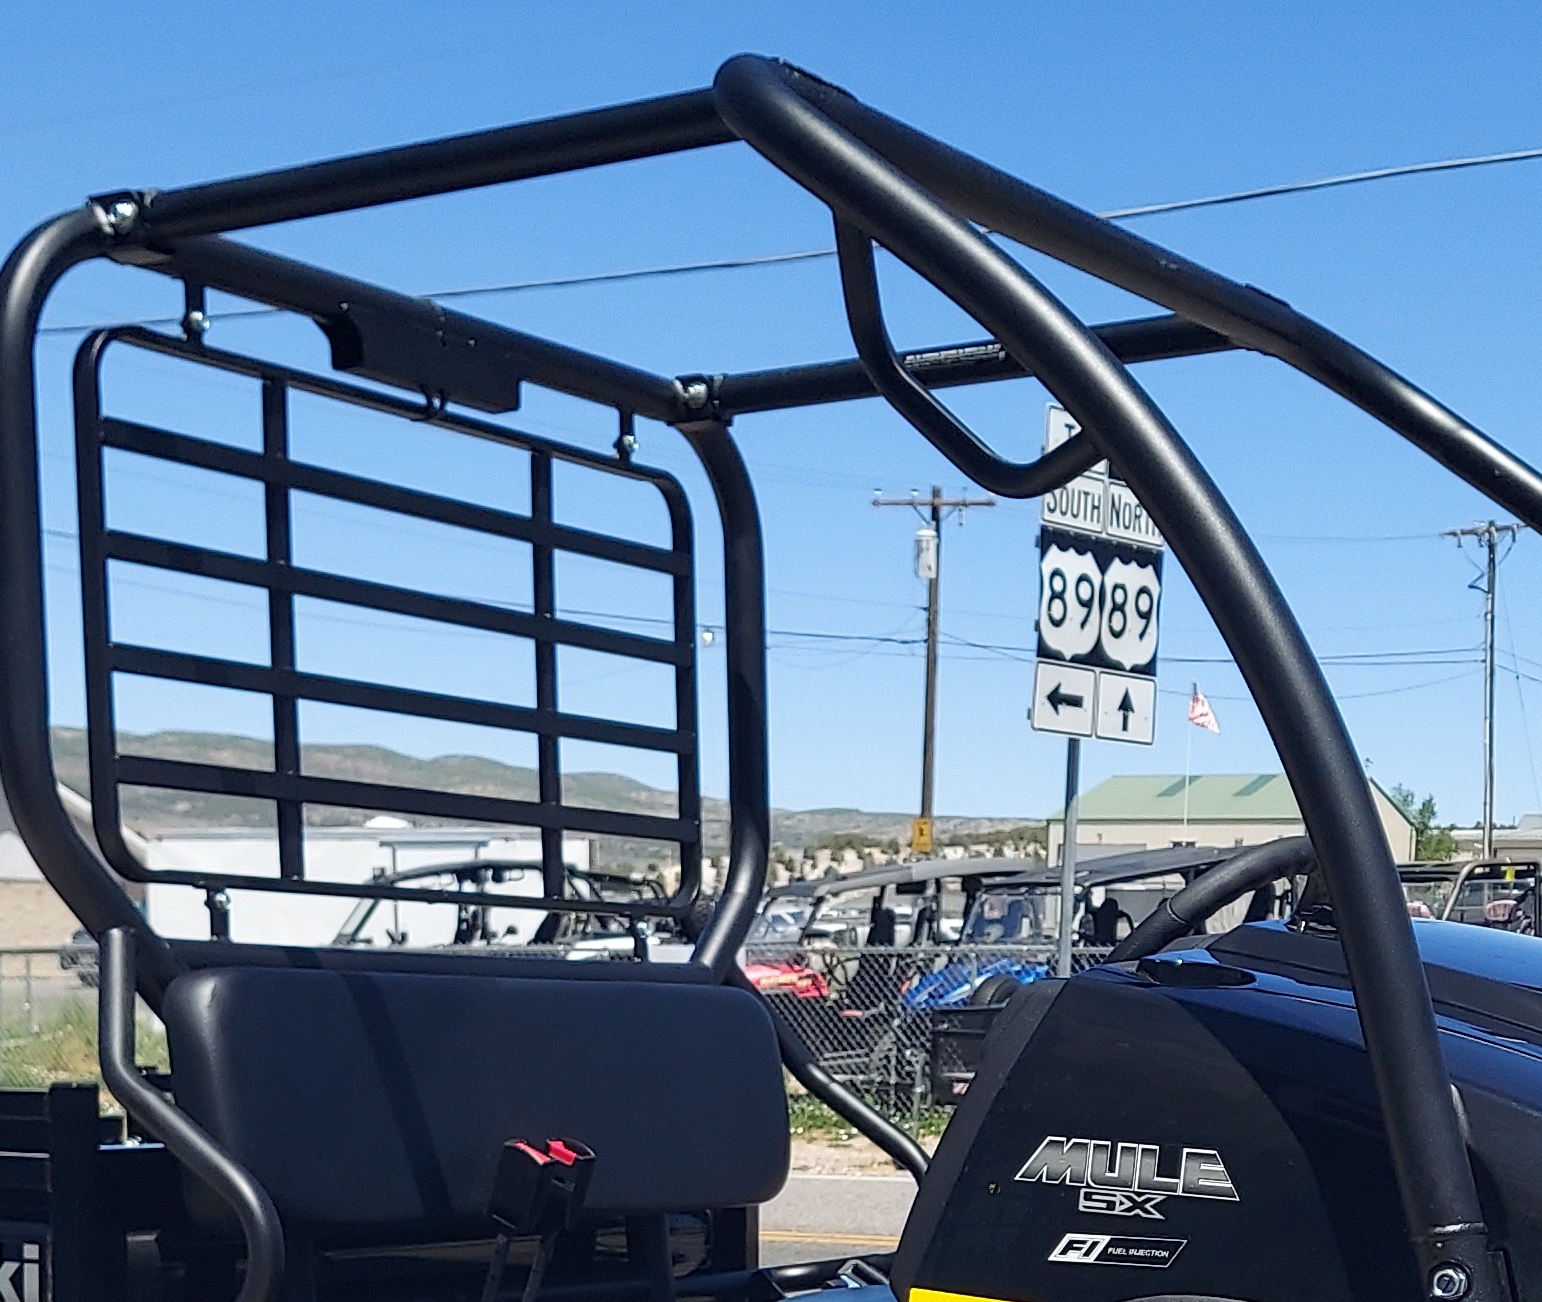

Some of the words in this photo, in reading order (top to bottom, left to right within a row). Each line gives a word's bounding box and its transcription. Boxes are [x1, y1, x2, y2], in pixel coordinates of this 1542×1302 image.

[1046, 487, 1101, 522] SOUTH
[1047, 567, 1095, 630] 89
[1108, 583, 1154, 641] 89
[1014, 1136, 1241, 1201] MULE
[1078, 1188, 1168, 1220] SX
[1056, 1237, 1104, 1259] FI
[1107, 1246, 1128, 1256] FUEL
[1128, 1248, 1170, 1259] INJECTION
